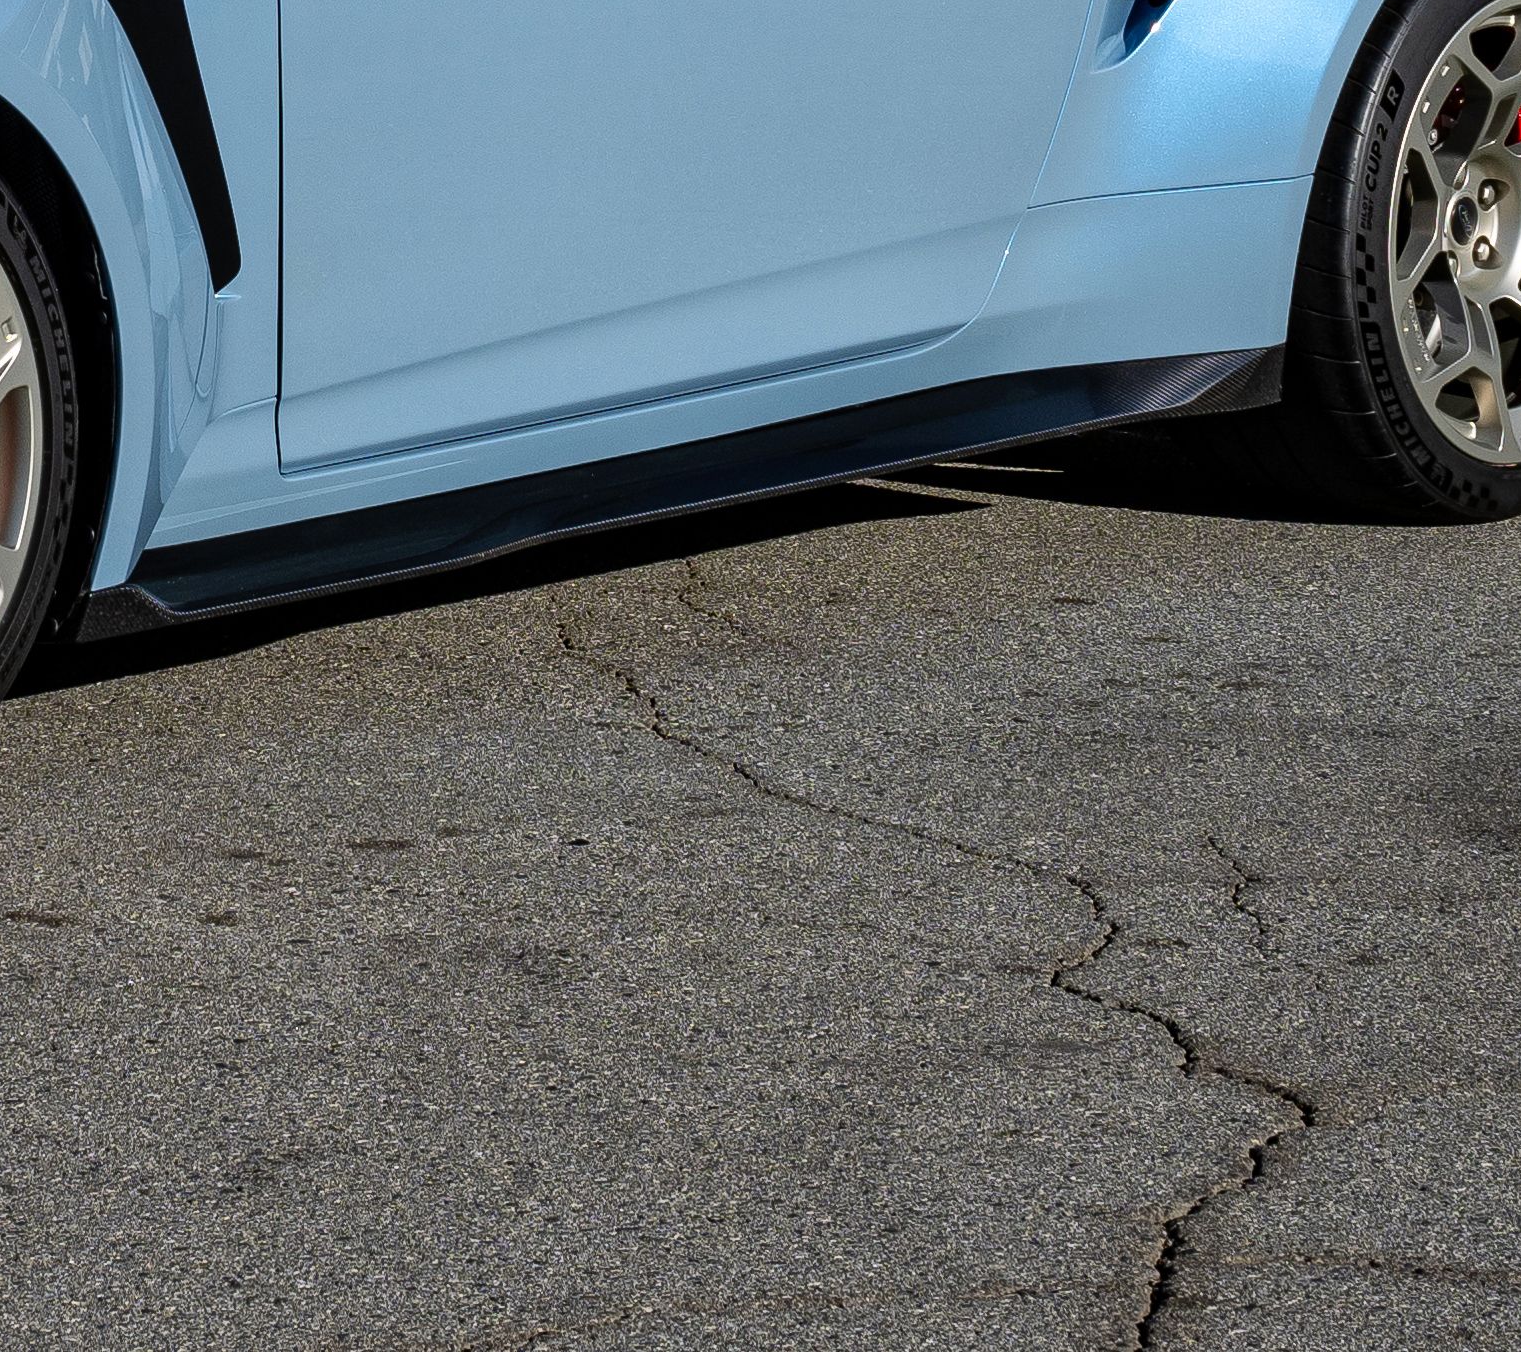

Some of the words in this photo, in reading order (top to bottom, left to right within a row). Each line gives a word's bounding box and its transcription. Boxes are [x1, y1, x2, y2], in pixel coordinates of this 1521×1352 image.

[1387, 85, 1400, 106] R
[1365, 144, 1383, 192] CUP
[1376, 123, 1388, 142] 2
[1364, 330, 1433, 465] MICHELIN
